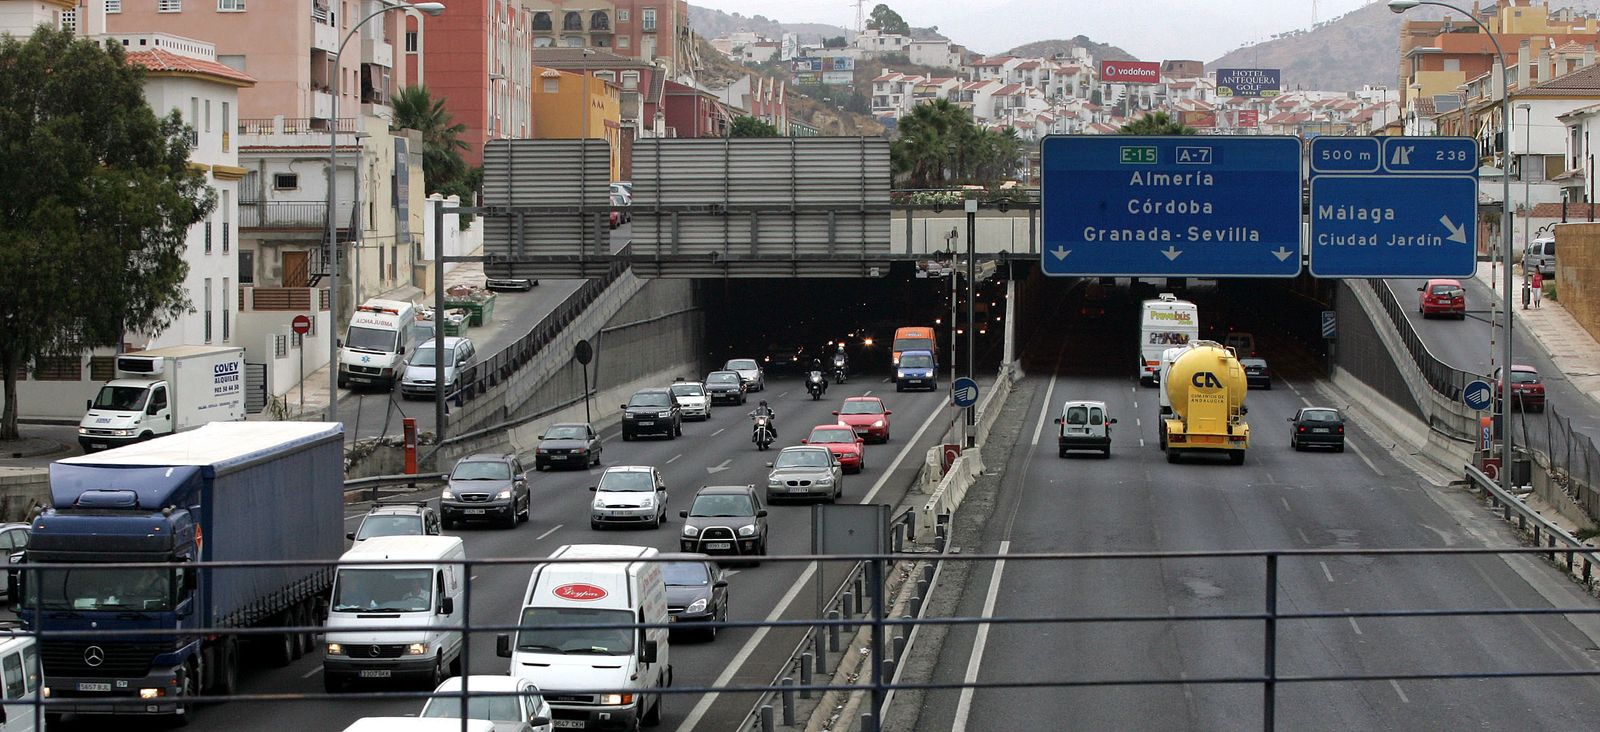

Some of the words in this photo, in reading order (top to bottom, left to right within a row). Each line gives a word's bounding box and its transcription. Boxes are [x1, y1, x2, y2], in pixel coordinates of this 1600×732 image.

[1118, 67, 1156, 77] vodafone
[1222, 76, 1275, 84] ANTEQUERA
[1121, 149, 1155, 161] E-15
[1179, 149, 1209, 161] A-7
[1322, 150, 1352, 160] 500
[1359, 152, 1371, 160] m
[1436, 150, 1467, 161] 238
[1130, 171, 1214, 186] Almería
[1128, 199, 1213, 214] Córdoba
[1318, 204, 1395, 223] Málaga
[1318, 233, 1378, 246] Ciudad
[214, 361, 239, 373] COVEY
[214, 375, 239, 384] ALQUILER
[1192, 372, 1223, 388] CA
